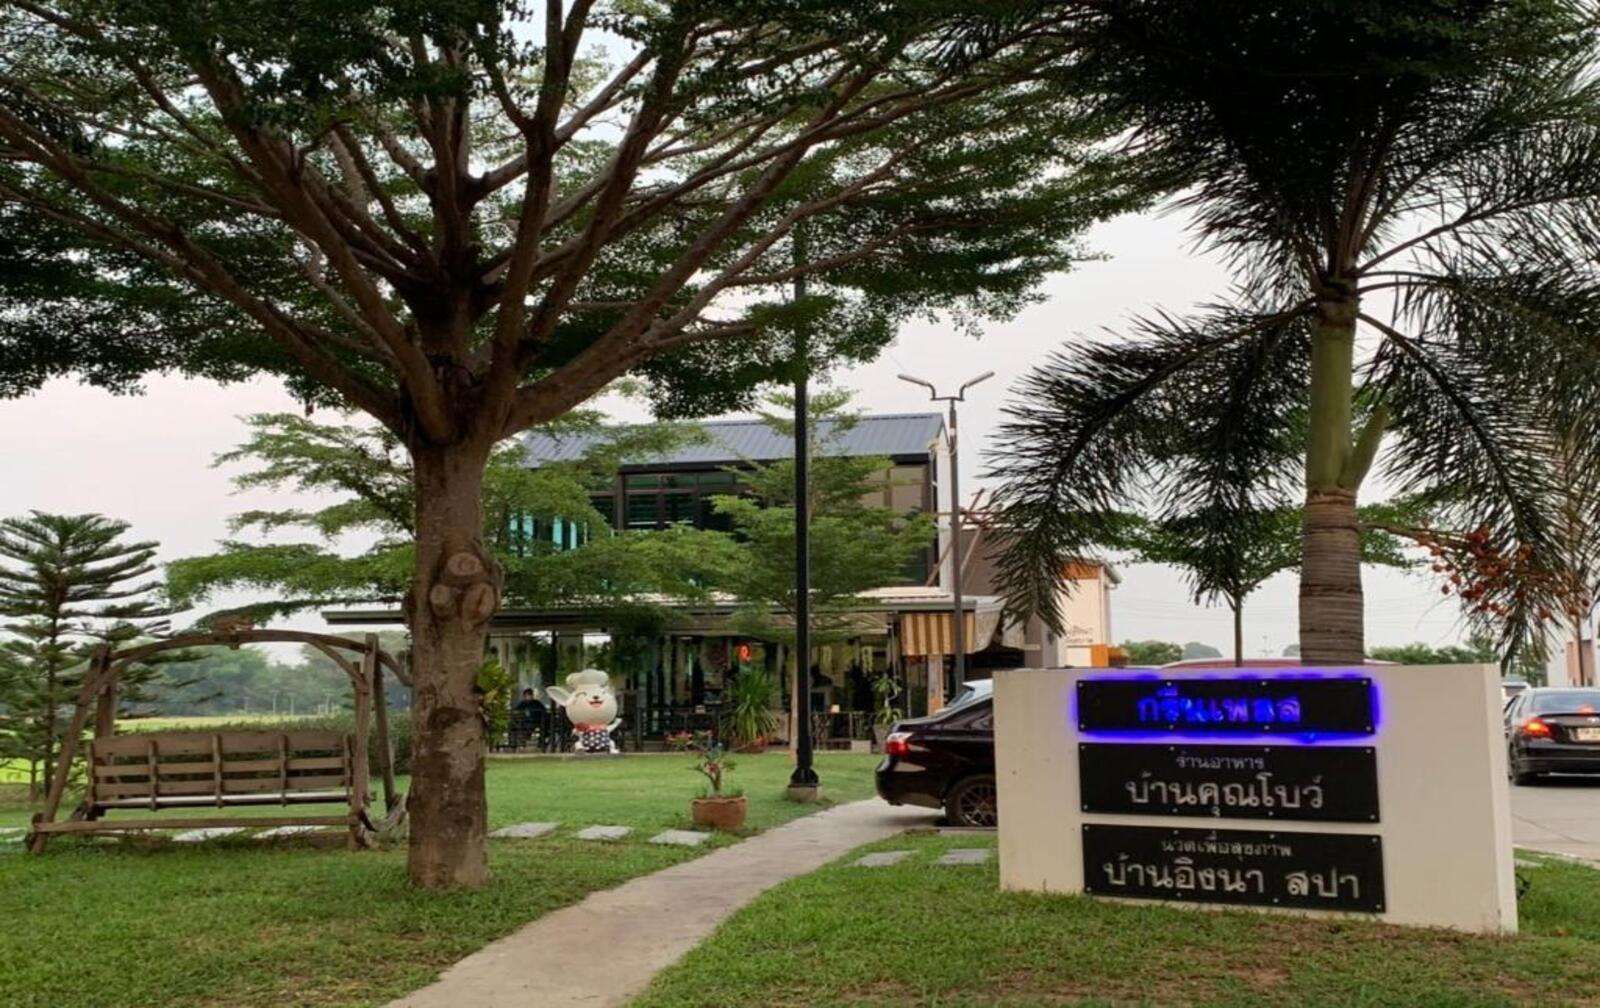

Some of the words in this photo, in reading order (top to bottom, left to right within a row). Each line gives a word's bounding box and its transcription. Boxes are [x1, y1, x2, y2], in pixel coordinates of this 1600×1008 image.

[1175, 752, 1265, 769] ร้านอาหาร
[1125, 771, 1324, 818] บ้านคุณโบว์
[1161, 830, 1293, 861] นวดเพื่อสุขภาพ
[1103, 854, 1265, 893] บ้านอิงนา
[1286, 867, 1360, 899] สปา
